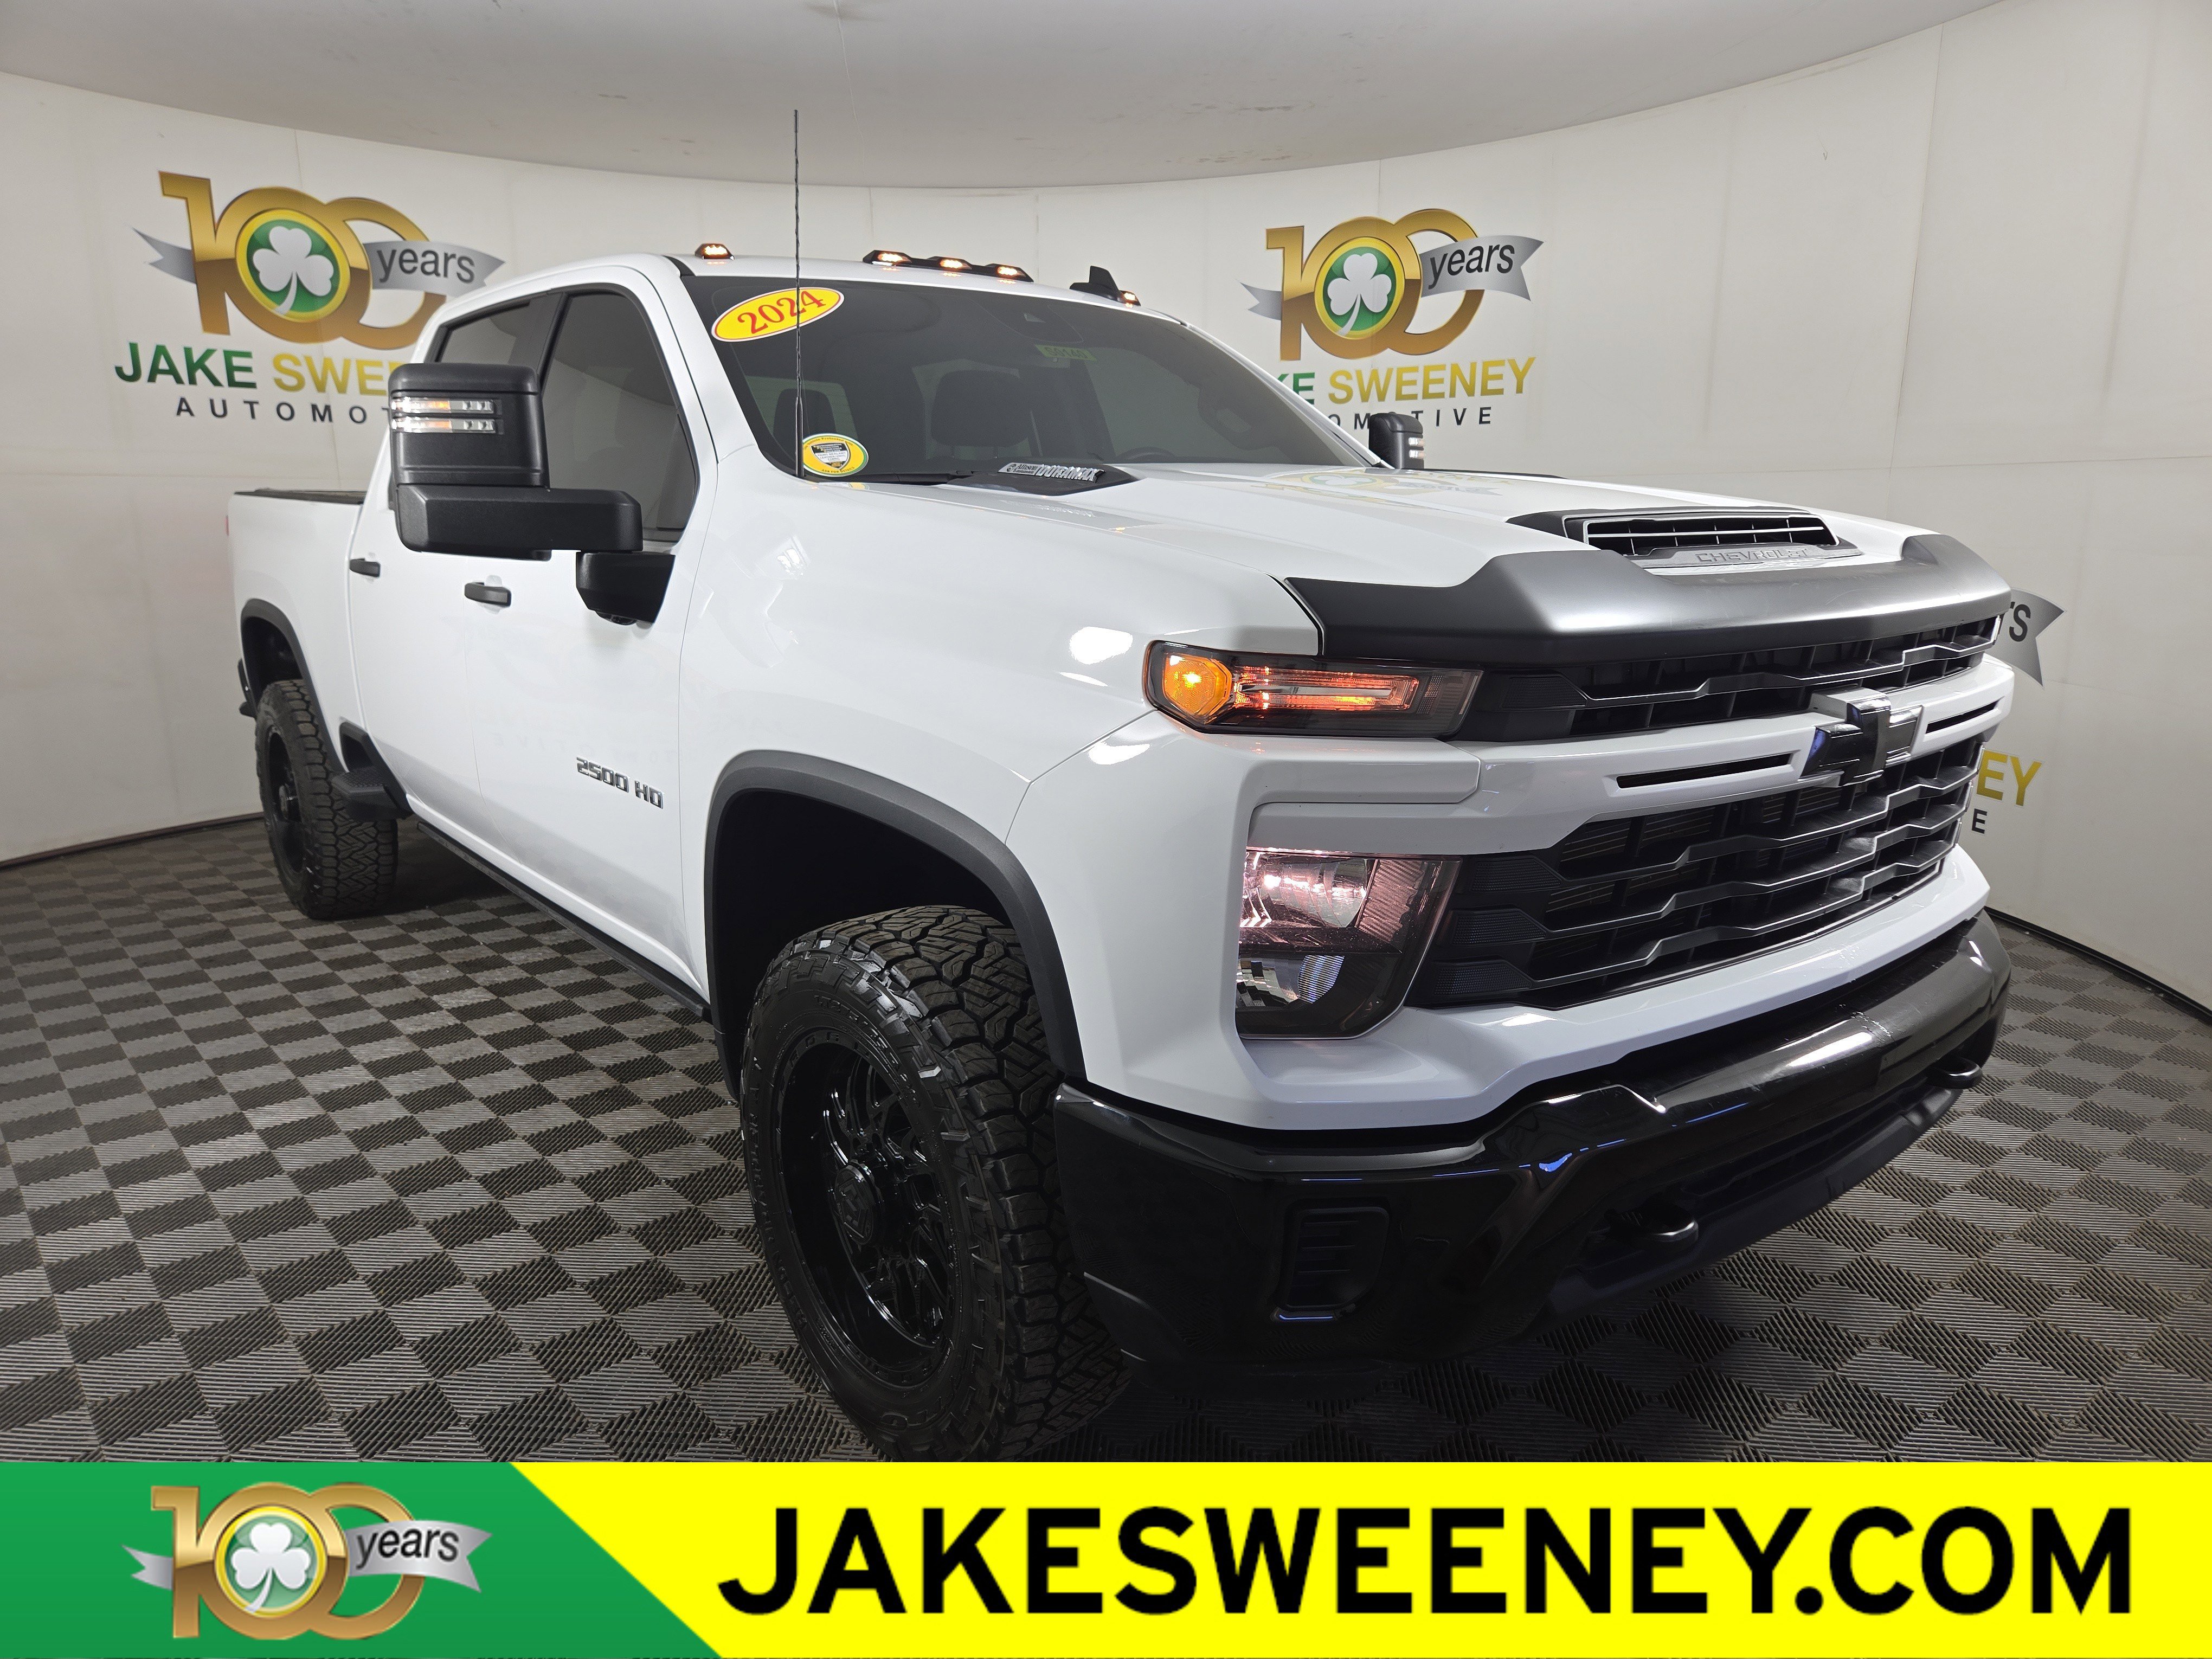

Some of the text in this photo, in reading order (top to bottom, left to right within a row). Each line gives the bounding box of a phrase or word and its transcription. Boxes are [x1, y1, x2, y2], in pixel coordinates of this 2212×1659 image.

[377, 247, 475, 284] years
[1266, 209, 1484, 361] 100
[1429, 241, 1515, 290] years
[737, 291, 826, 334] 2024
[114, 342, 257, 389] JAKE
[1328, 357, 1536, 404] SWEENEY
[176, 397, 390, 423] AUTOMO
[1696, 548, 1809, 563] CHEVROLET
[576, 756, 664, 809] 2500 HD
